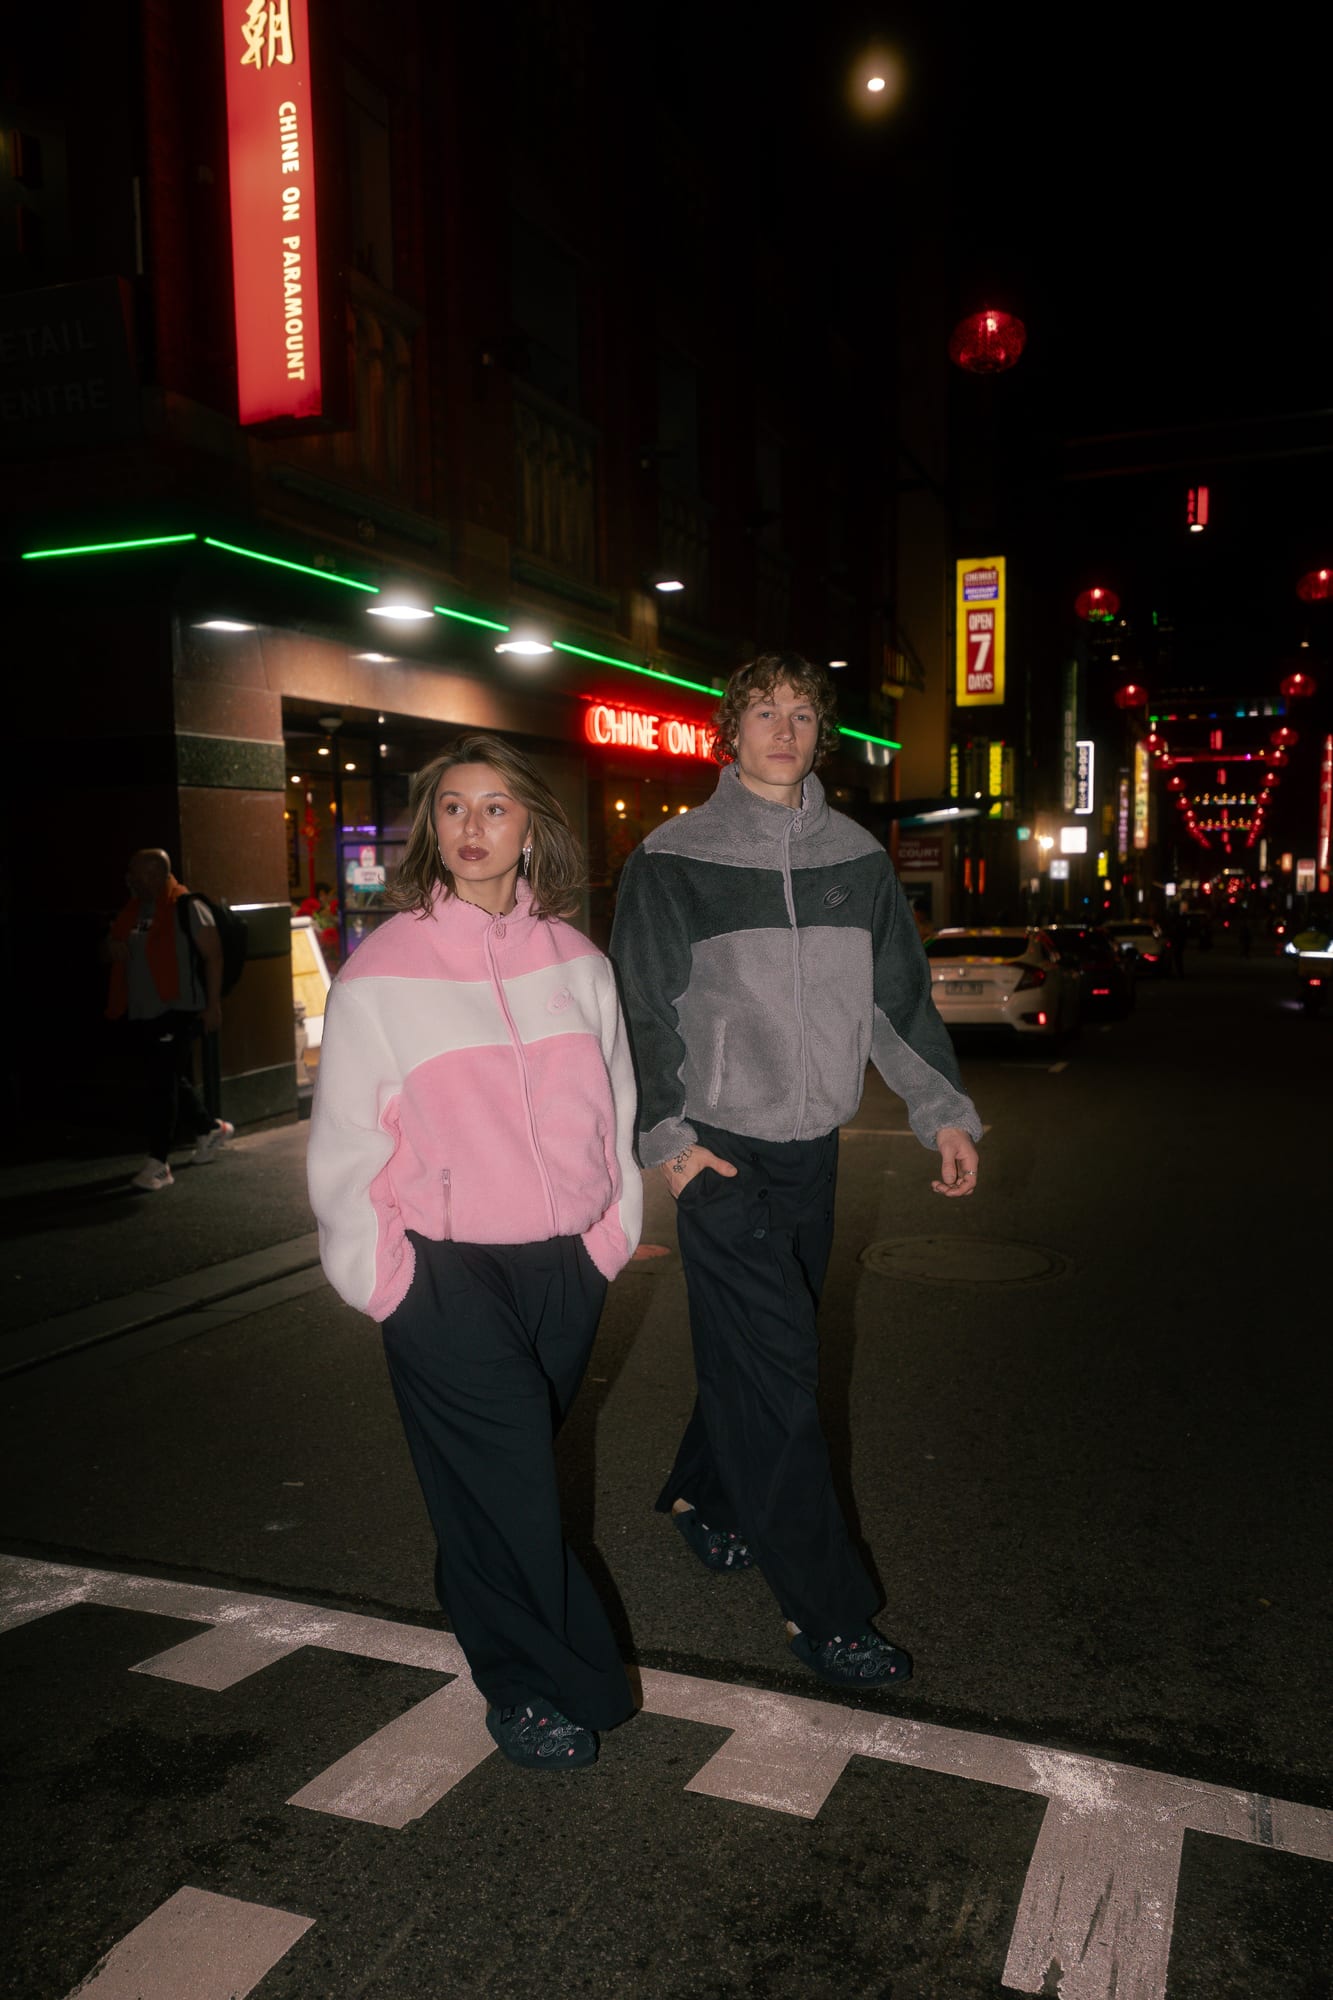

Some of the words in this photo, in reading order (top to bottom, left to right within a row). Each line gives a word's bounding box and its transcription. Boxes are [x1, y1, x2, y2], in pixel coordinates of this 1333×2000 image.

[278, 101, 300, 174] CHINE
[282, 186, 301, 221] ON
[282, 235, 304, 380] PARAMOUNT
[968, 612, 993, 631] OPEN
[970, 633, 992, 672] 7
[967, 674, 993, 691] DAYS
[588, 704, 659, 750] CHINE
[665, 720, 696, 755] ON
